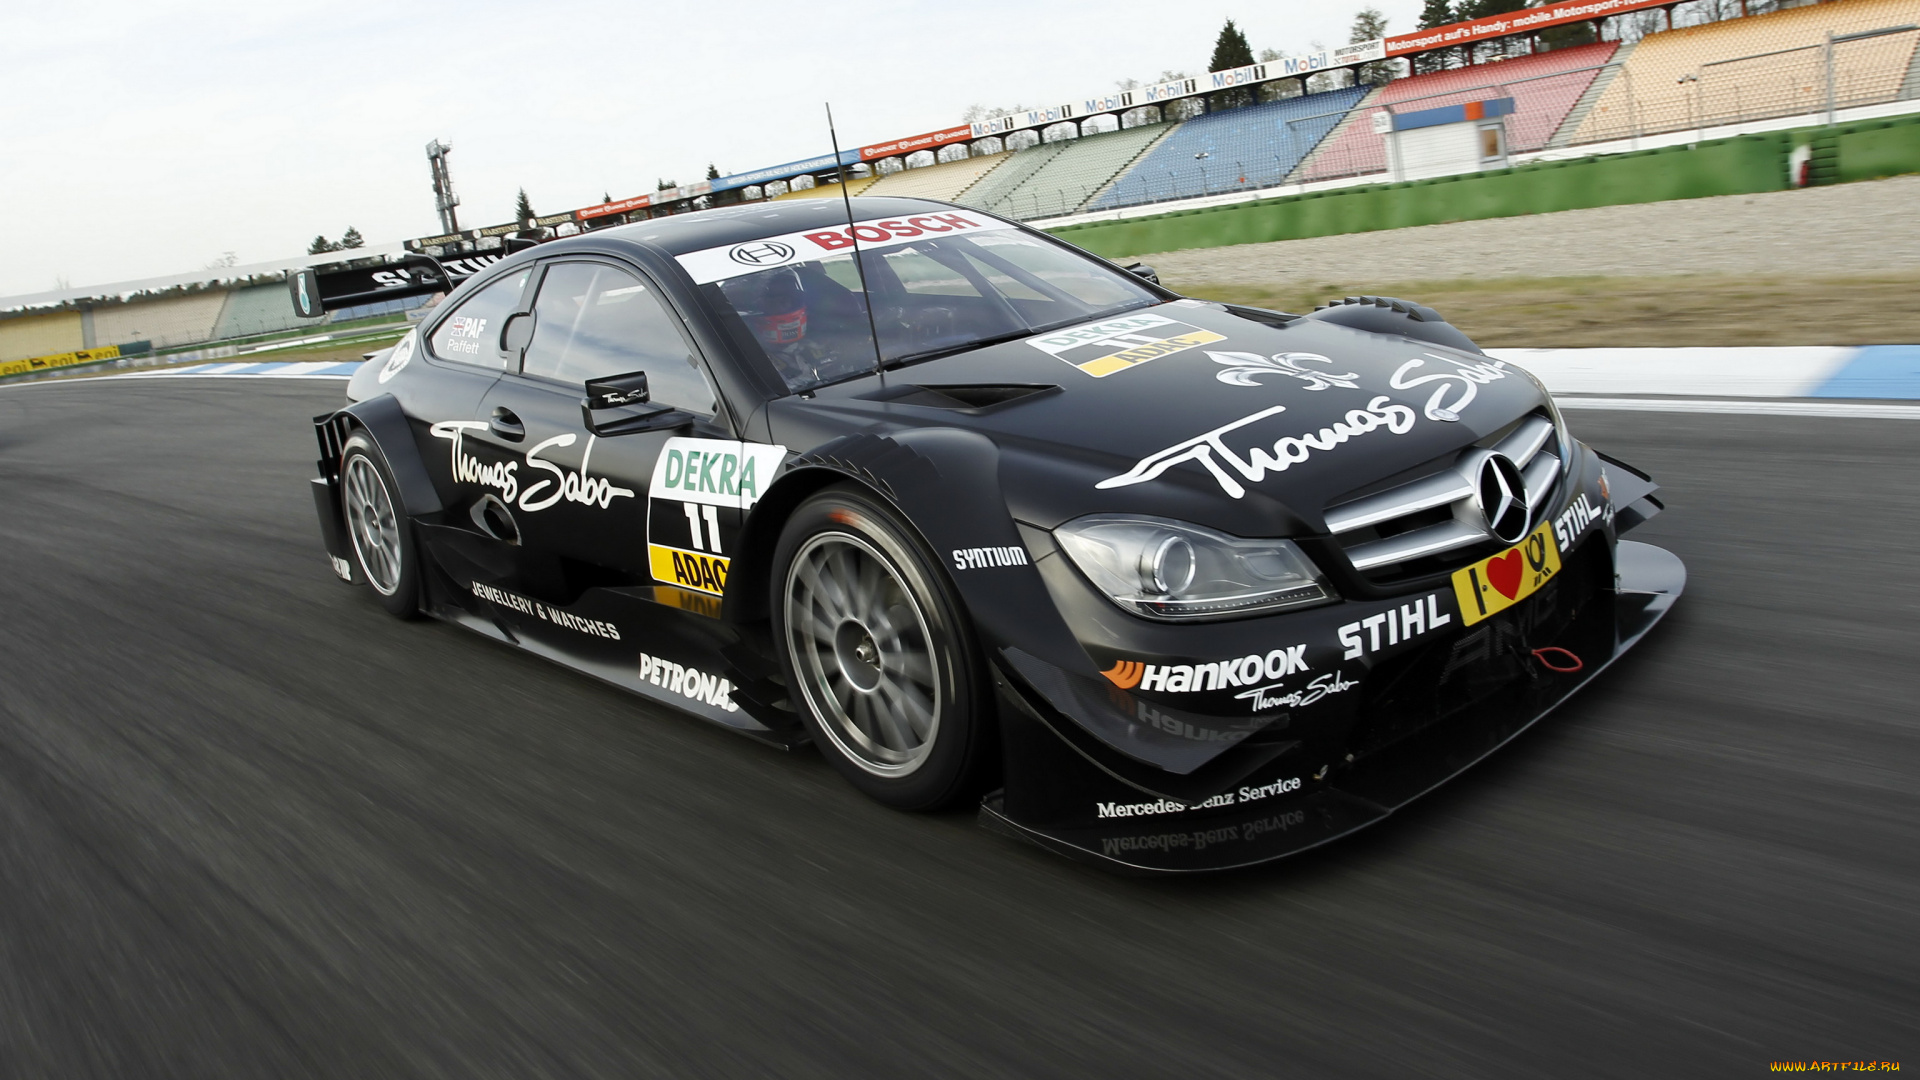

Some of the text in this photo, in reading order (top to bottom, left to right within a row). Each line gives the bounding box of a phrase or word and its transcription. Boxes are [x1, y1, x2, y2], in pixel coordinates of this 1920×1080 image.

[1386, 32, 1443, 52] Motorsport
[1444, 27, 1471, 41] auf's
[1472, 20, 1511, 35] Handy:
[1284, 52, 1328, 74] Mobil
[1212, 67, 1251, 88] Mobil
[1086, 94, 1121, 113] Mobil
[1146, 81, 1183, 102] Mobil
[972, 119, 1003, 136] Mobil
[1028, 106, 1060, 125] Mobil
[802, 213, 982, 251] BOSCH
[463, 317, 487, 339] PAF
[1038, 318, 1167, 347] DEKRA
[95, 346, 119, 360] eni
[447, 338, 480, 355] Paffett
[1092, 333, 1167, 350] 11
[1112, 338, 1202, 364] ADAC
[3, 360, 28, 375] eni
[50, 353, 73, 367] eni
[1095, 352, 1508, 499] Thomas Sabo
[430, 420, 636, 512] Thomas Sabo
[665, 448, 758, 499] DEKRA
[683, 501, 723, 554] 11
[1554, 493, 1602, 553] STIHL
[952, 546, 1029, 570] SYNTIUM
[671, 551, 728, 592] ADAC
[1468, 567, 1487, 616] I
[472, 580, 621, 640] JEWELLERY & WATCHES
[1338, 594, 1451, 661] STIHL
[1234, 669, 1360, 712] Thomas Sabo
[1238, 776, 1301, 803] Service
